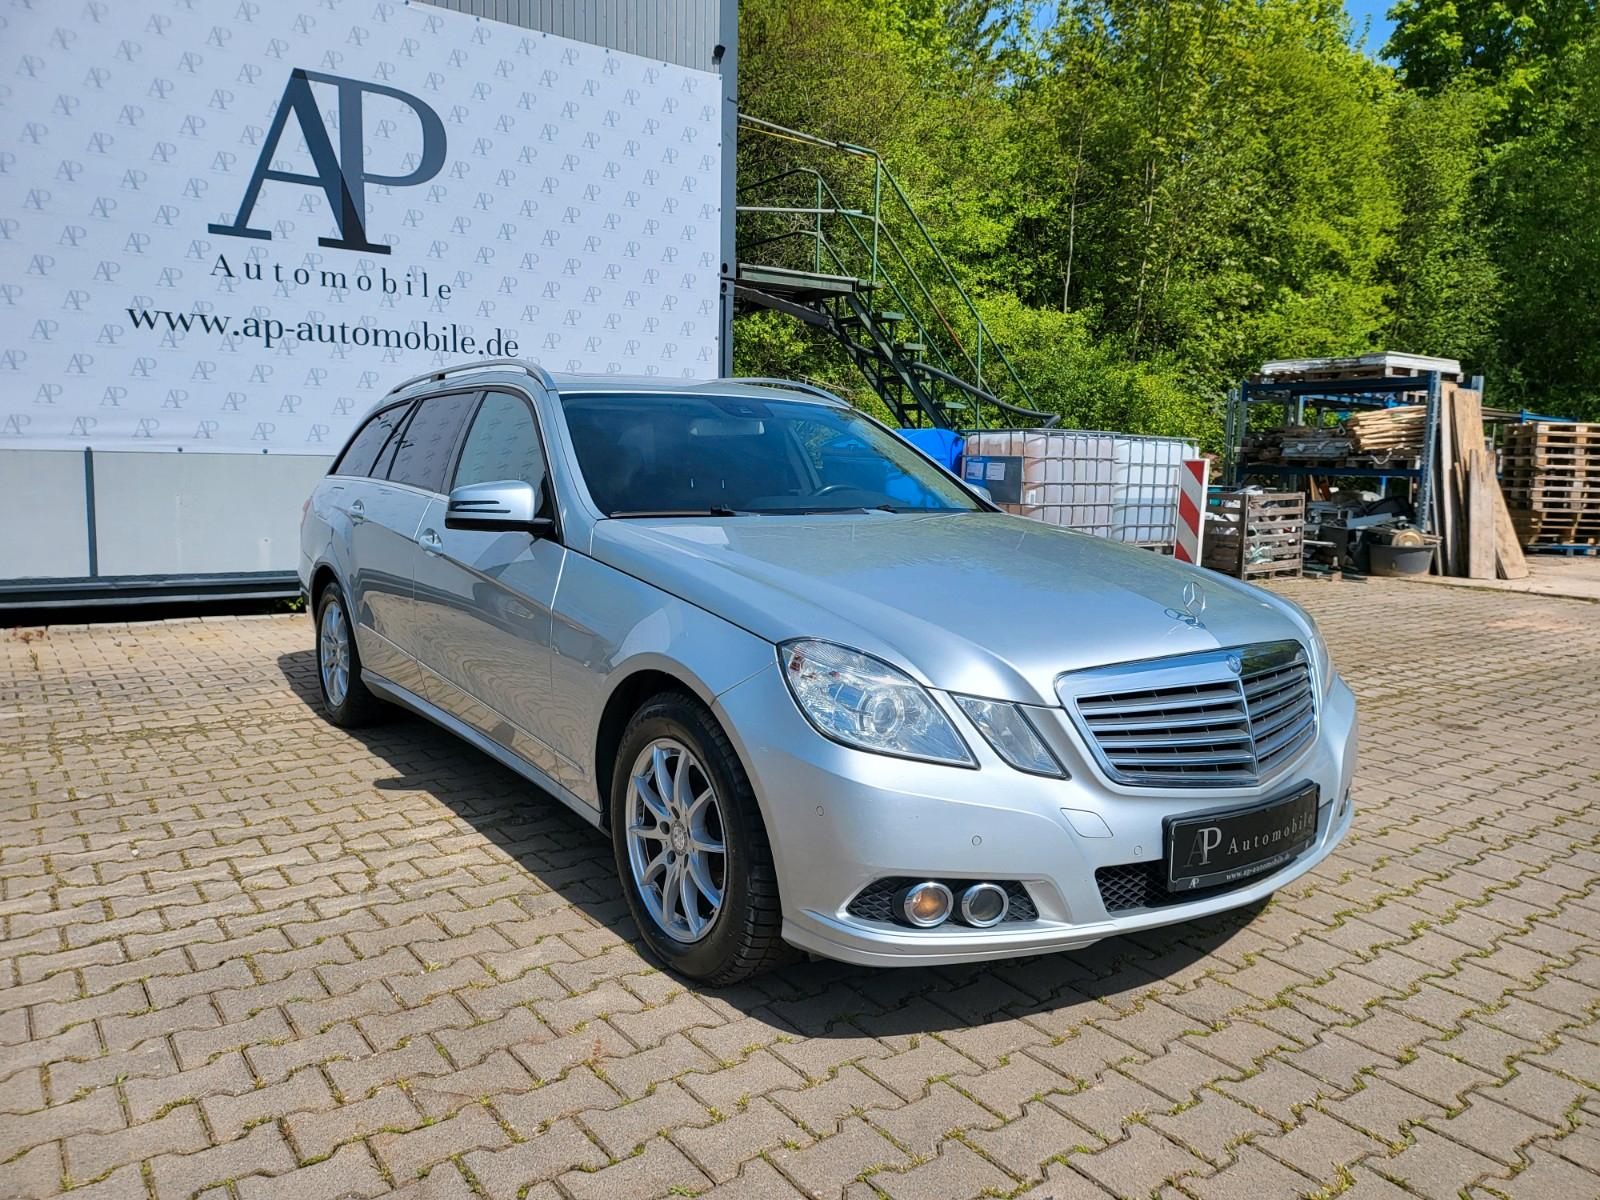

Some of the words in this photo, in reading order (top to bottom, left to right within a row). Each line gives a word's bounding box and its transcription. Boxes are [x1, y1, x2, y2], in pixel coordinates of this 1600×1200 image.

[235, 0, 260, 20] AP
[372, 3, 394, 22] AP
[144, 14, 171, 34] AP
[292, 14, 316, 35] AP
[422, 14, 444, 33] AP
[206, 26, 232, 46] AP
[345, 26, 369, 46] AP
[470, 27, 491, 44] AP
[114, 40, 142, 62] AP
[264, 38, 289, 58] AP
[398, 38, 420, 58] AP
[515, 37, 536, 55] AP
[177, 52, 203, 72] AP
[320, 50, 344, 69] AP
[446, 49, 468, 68] AP
[560, 48, 579, 66] AP
[602, 57, 620, 74] AP
[83, 67, 111, 87] AP
[236, 64, 262, 84] AP
[374, 61, 396, 80] AP
[494, 59, 514, 77] AP
[642, 67, 660, 83] AP
[422, 72, 445, 92] AP
[538, 69, 558, 87] AP
[581, 79, 600, 96] AP
[680, 77, 698, 94] AP
[146, 78, 174, 98] AP
[470, 82, 492, 101] AP
[622, 88, 640, 105] AP
[208, 89, 234, 110] AP
[517, 92, 536, 110] AP
[661, 97, 679, 113] AP
[116, 105, 144, 126] AP
[448, 104, 469, 123] AP
[560, 101, 579, 119] AP
[602, 109, 620, 126] AP
[699, 106, 715, 122] AP
[178, 115, 206, 137] AP
[374, 120, 397, 140] AP
[493, 114, 515, 134] AP
[539, 123, 558, 142] AP
[642, 118, 660, 135] AP
[86, 132, 114, 153] AP
[240, 125, 263, 145] AP
[582, 132, 600, 150] AP
[680, 126, 697, 142] AP
[149, 142, 177, 163] AP
[472, 137, 493, 157] AP
[516, 145, 538, 165] AP
[623, 140, 640, 158] AP
[661, 147, 679, 165] AP
[54, 160, 83, 181] AP
[208, 67, 447, 255] AP
[210, 151, 237, 172] AP
[448, 161, 470, 180] AP
[560, 154, 580, 172] AP
[601, 161, 621, 180] AP
[698, 155, 714, 171] AP
[120, 169, 147, 190] AP
[495, 169, 516, 188] AP
[539, 176, 559, 194] AP
[642, 169, 660, 187] AP
[680, 176, 697, 193] AP
[182, 178, 208, 199] AP
[424, 185, 447, 205] AP
[582, 184, 601, 202] AP
[22, 189, 51, 210] AP
[88, 197, 117, 219] AP
[296, 194, 321, 215] AP
[472, 192, 494, 211] AP
[622, 191, 640, 208] AP
[661, 197, 679, 214] AP
[152, 205, 180, 227] AP
[401, 209, 424, 229] AP
[517, 200, 538, 219] AP
[561, 206, 581, 224] AP
[699, 204, 714, 219] AP
[273, 219, 295, 239] AP
[449, 216, 471, 235] AP
[602, 213, 621, 231] AP
[642, 217, 660, 234] AP
[56, 225, 87, 246] AP
[496, 223, 517, 242] AP
[540, 229, 560, 247] AP
[680, 225, 696, 241] AP
[122, 232, 151, 254] AP
[184, 240, 211, 261] AP
[426, 240, 449, 259] AP
[582, 236, 601, 254] AP
[622, 240, 640, 258] AP
[25, 254, 55, 275] AP
[473, 246, 495, 266] AP
[518, 252, 539, 271] AP
[562, 256, 581, 274] AP
[660, 247, 678, 264] AP
[698, 252, 714, 268] AP
[92, 261, 120, 283] AP
[155, 267, 183, 288] AP
[210, 254, 452, 300] Automobile
[452, 271, 473, 289] AP
[602, 264, 621, 282] AP
[642, 268, 660, 286] AP
[680, 272, 696, 288] AP
[498, 273, 518, 292] AP
[541, 281, 560, 300] AP
[61, 290, 90, 311] AP
[582, 286, 602, 304] AP
[622, 288, 640, 305] AP
[660, 295, 678, 312] AP
[475, 300, 496, 319] AP
[520, 305, 540, 324] AP
[696, 299, 713, 316] AP
[562, 309, 581, 327] AP
[602, 313, 621, 330] AP
[642, 317, 659, 334] AP
[29, 319, 59, 340] AP
[96, 324, 124, 344] AP
[126, 307, 519, 357] www.ap-automobile.de
[680, 321, 695, 336] AP
[541, 332, 561, 350] AP
[584, 336, 602, 352] AP
[622, 340, 640, 357] AP
[0, 349, 27, 370] AP
[660, 343, 677, 359] AP
[696, 346, 712, 362] AP
[64, 353, 94, 375] AP
[130, 357, 157, 378] AP
[191, 361, 216, 382] AP
[248, 364, 274, 383] AP
[304, 368, 328, 388] AP
[356, 371, 379, 391] AP
[33, 384, 63, 405] AP
[99, 386, 128, 408] AP
[161, 389, 189, 410] AP
[221, 392, 247, 412] AP
[277, 395, 302, 415] AP
[332, 397, 355, 415] AP
[3, 414, 31, 434] AP
[70, 416, 97, 436] AP
[133, 418, 160, 437] AP
[194, 420, 219, 439] AP
[252, 423, 276, 440] AP
[305, 424, 330, 444] AP
[1184, 827, 1222, 868] AP
[1228, 814, 1313, 855] Automobile
